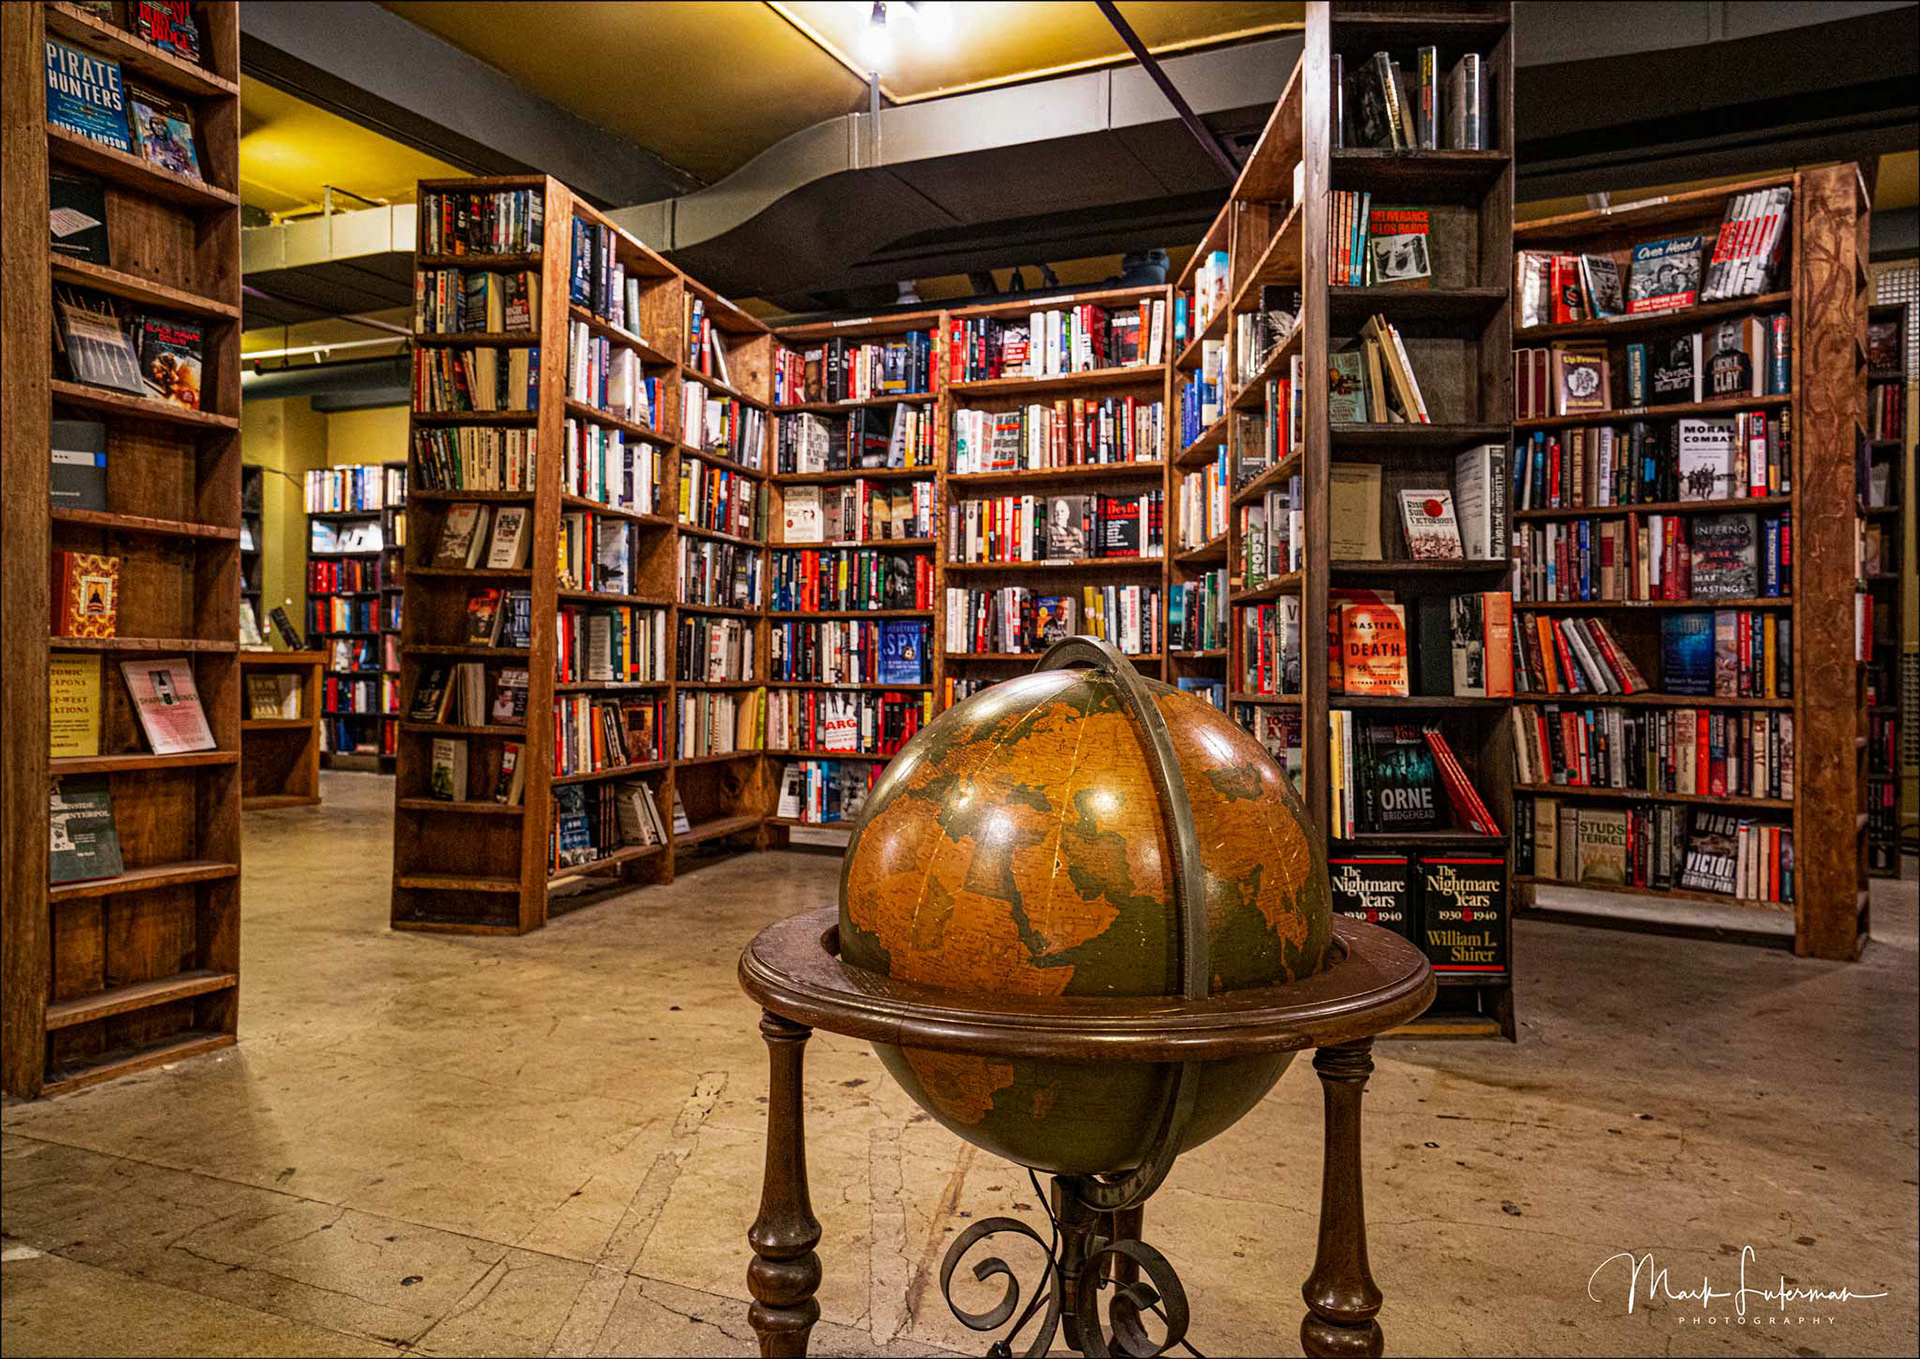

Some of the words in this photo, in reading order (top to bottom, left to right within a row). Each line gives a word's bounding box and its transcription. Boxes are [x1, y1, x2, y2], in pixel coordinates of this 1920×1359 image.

[46, 42, 120, 92] PIRATE
[48, 68, 122, 111] HUNTERS
[91, 132, 128, 150] KURSON
[1684, 425, 1735, 434] MORAL
[1695, 525, 1748, 535] INFERNO
[1694, 574, 1716, 583] MAX
[1694, 584, 1745, 593] HASTINGS
[1349, 621, 1400, 630] MASTERS
[1371, 632, 1381, 640] of
[886, 634, 919, 656] SPY
[1350, 642, 1401, 657] DEATH
[50, 668, 83, 676] TOMIC
[825, 719, 858, 731] ARG
[1380, 787, 1434, 810] ORNE
[1382, 809, 1436, 821] BRIDGEHEAD
[1579, 821, 1625, 835] STUDS
[1695, 811, 1740, 837] WING
[1579, 834, 1625, 846] TERKEL
[1341, 865, 1361, 877] The
[1437, 865, 1457, 877] The
[1686, 852, 1736, 878] VICTOR
[1332, 876, 1406, 897] Nightmare
[1426, 875, 1500, 896] Nightmare
[1358, 891, 1396, 908] Years
[1454, 891, 1490, 908] Years
[1378, 911, 1403, 921] 1940
[1439, 910, 1462, 920] 1930
[1473, 910, 1498, 920] 1940
[1427, 930, 1482, 947] William
[1484, 931, 1498, 947] L.
[1451, 946, 1495, 962] Shirer
